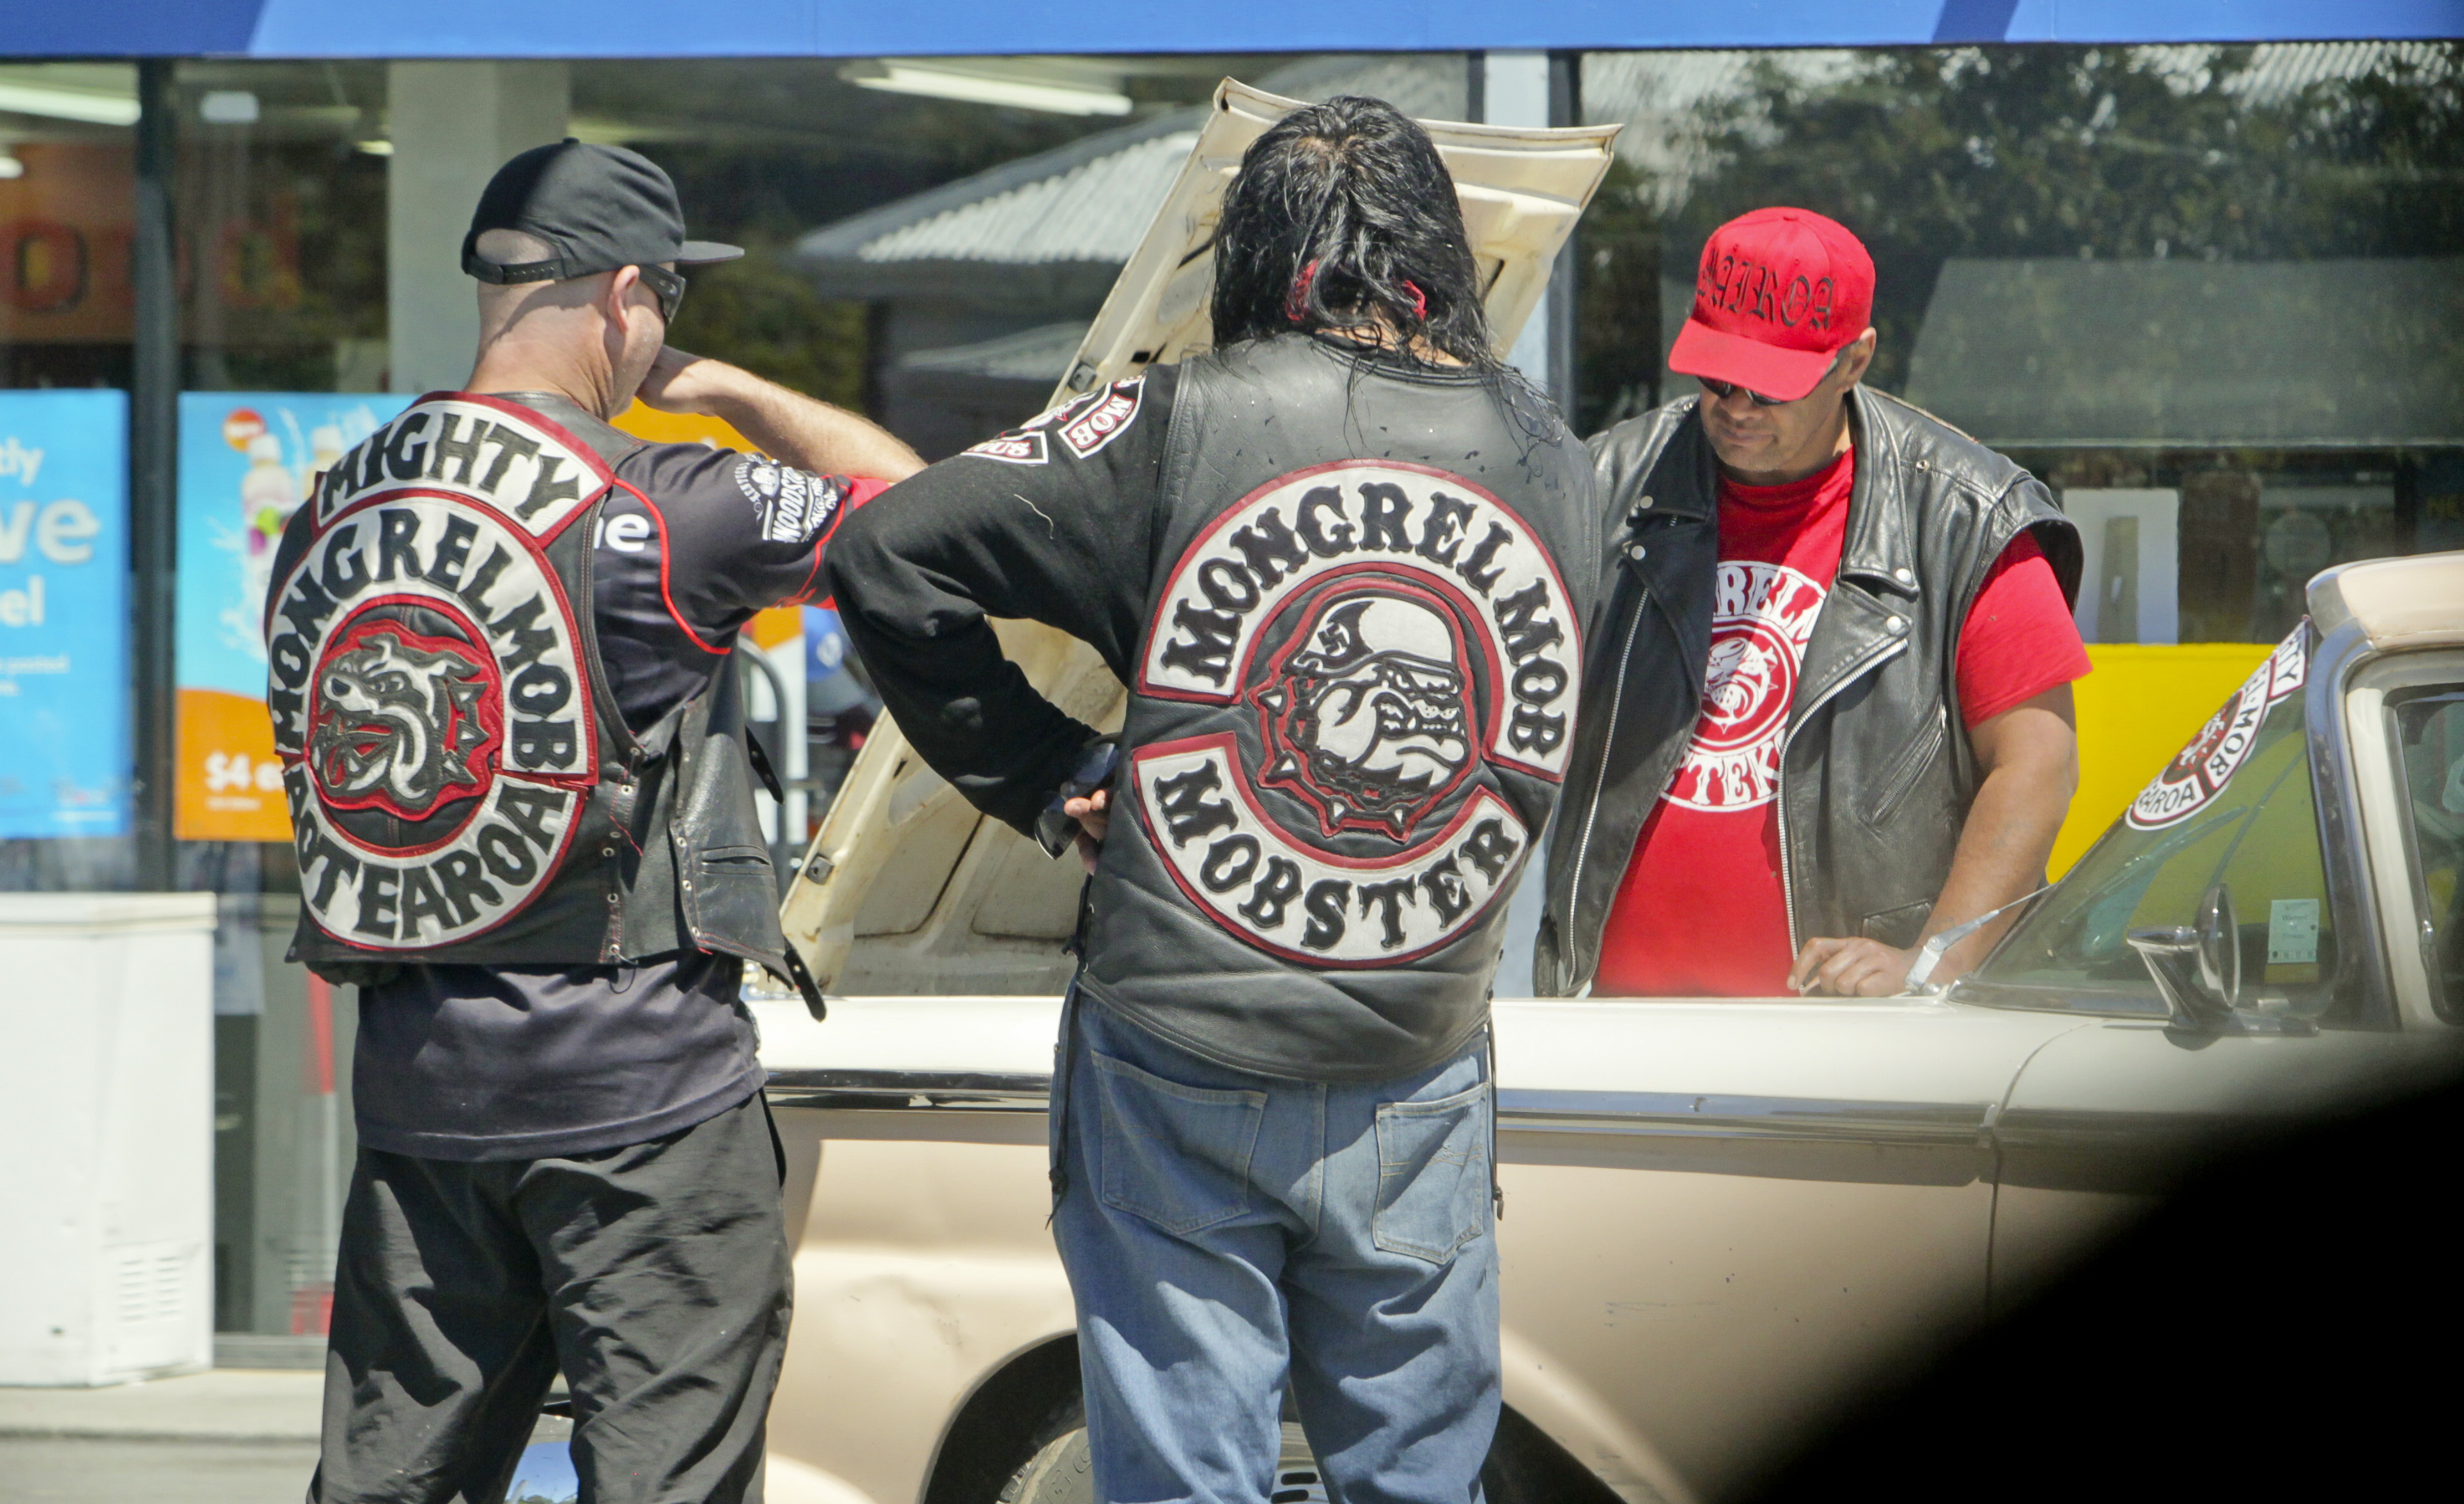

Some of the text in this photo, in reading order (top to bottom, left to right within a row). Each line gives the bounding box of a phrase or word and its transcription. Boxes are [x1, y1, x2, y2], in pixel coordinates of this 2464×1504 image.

[321, 412, 579, 521] MIGHTY
[1070, 395, 1134, 447] MOB
[270, 508, 579, 770] MONGREL MOB
[1160, 482, 1568, 758] MONGREL MOB
[205, 750, 253, 792] $4
[2210, 705, 2260, 777] MOB
[2139, 781, 2197, 814] EAROA
[286, 765, 566, 941] AOTEAROA
[1154, 758, 1520, 950] MOBSTER
